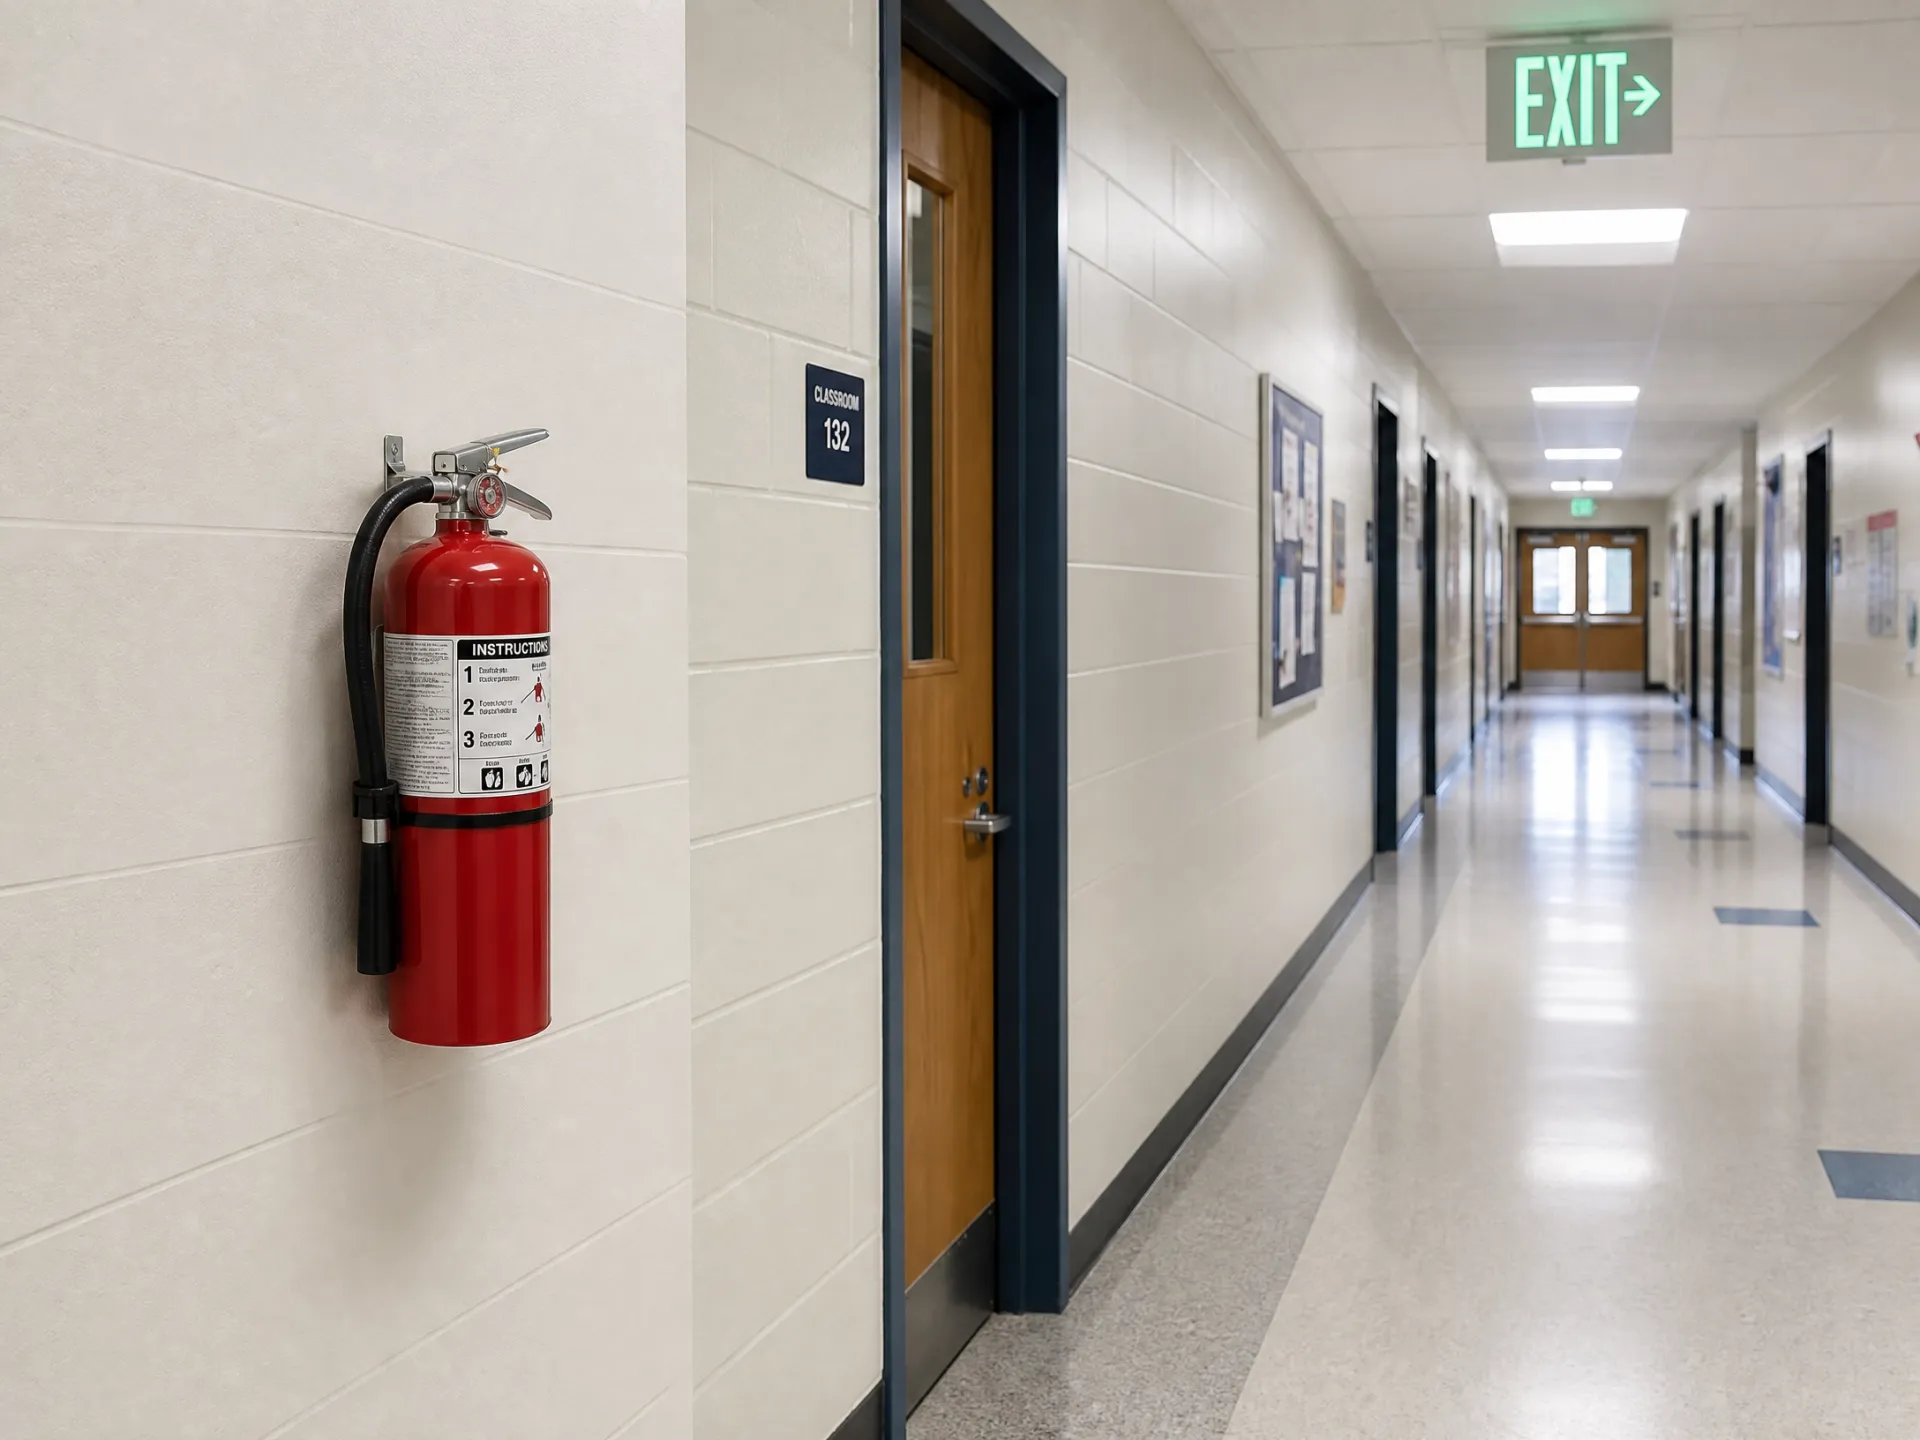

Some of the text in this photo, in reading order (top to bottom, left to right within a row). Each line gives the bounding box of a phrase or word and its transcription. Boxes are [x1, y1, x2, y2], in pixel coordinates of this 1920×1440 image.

[1515, 52, 1628, 148] EXIT
[814, 385, 860, 411] CLASSROOM
[824, 417, 851, 452] 132
[472, 640, 549, 657] INSTRUCTIONS
[464, 666, 472, 683] 1
[463, 698, 475, 716] 2
[463, 730, 475, 748] 3
